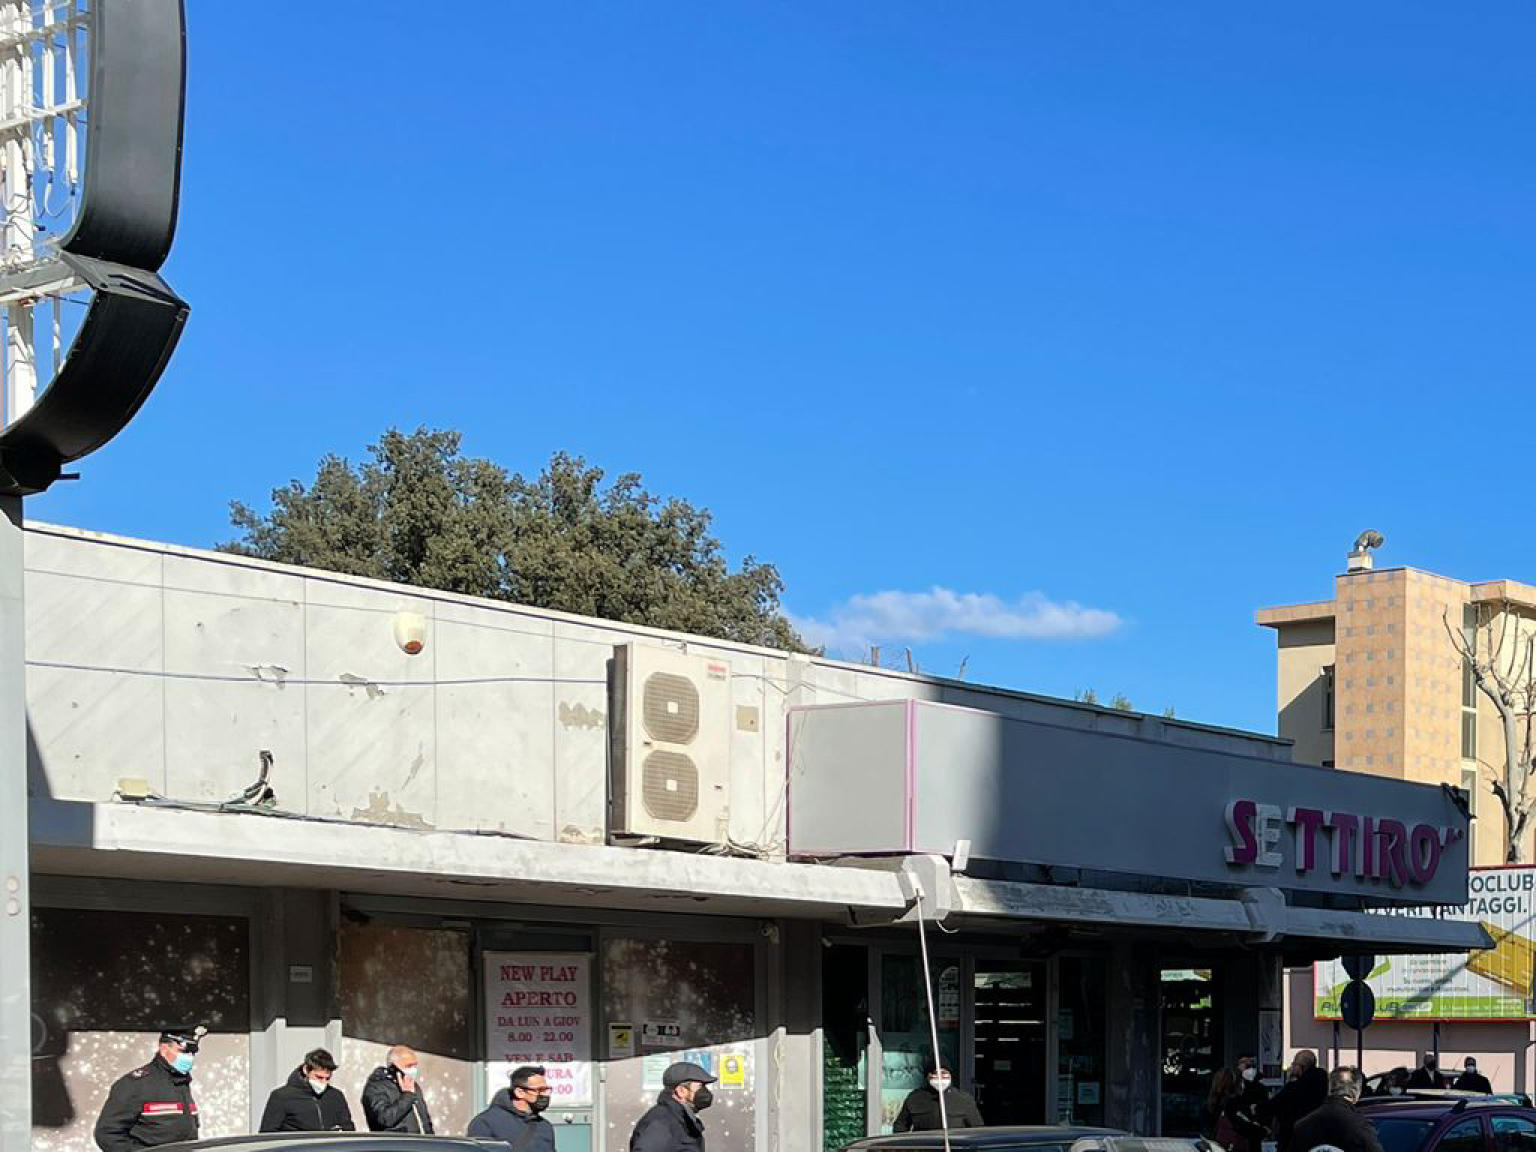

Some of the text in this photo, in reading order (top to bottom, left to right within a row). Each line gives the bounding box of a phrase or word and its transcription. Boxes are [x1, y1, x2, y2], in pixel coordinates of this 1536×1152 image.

[500, 966, 578, 982] NEW PLAY
[502, 991, 577, 1006] APERTO
